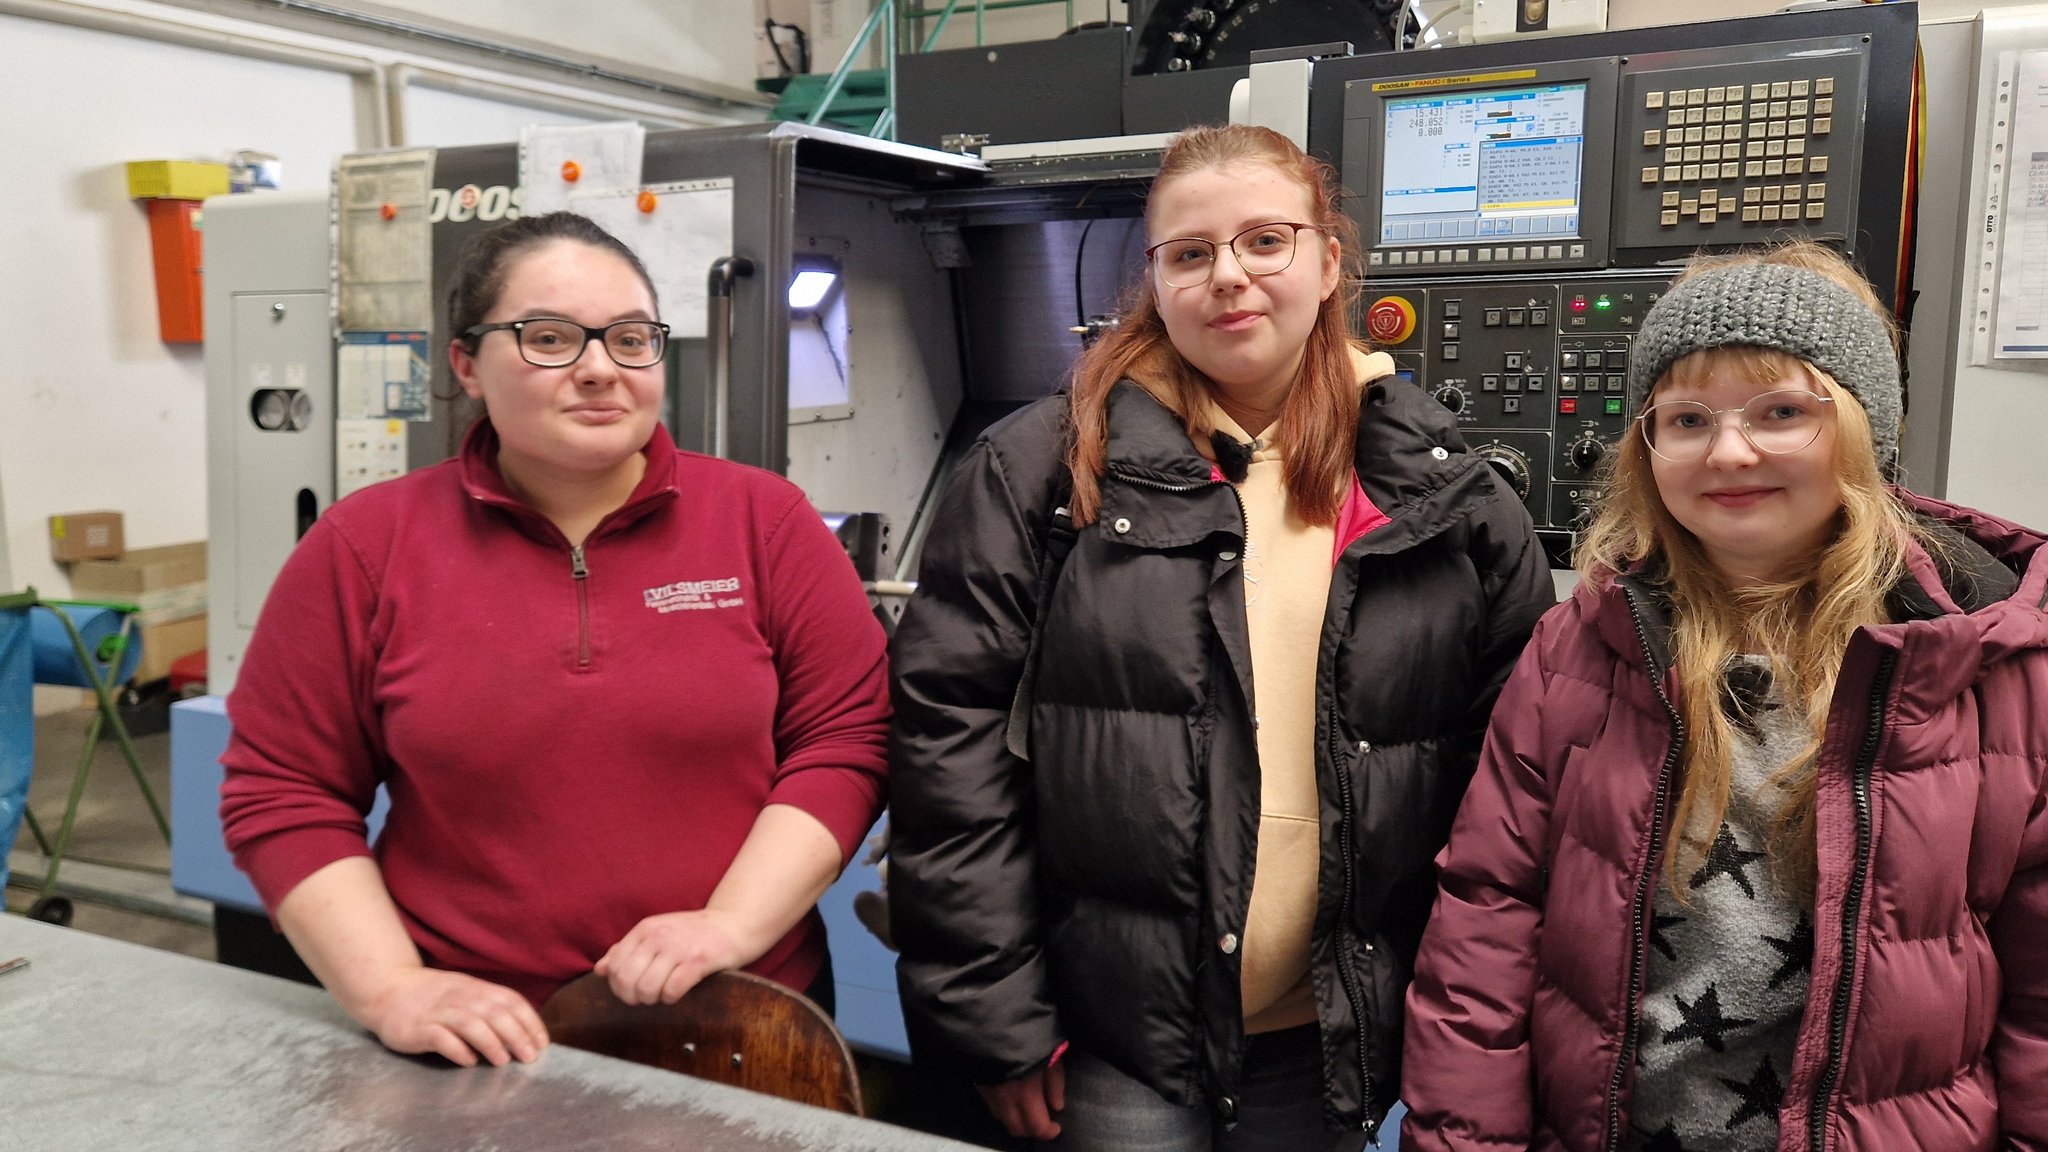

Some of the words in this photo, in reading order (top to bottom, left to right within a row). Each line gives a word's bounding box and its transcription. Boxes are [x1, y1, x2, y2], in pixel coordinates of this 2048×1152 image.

[1415, 108, 1442, 118] 15.431
[1418, 127, 1443, 137] 0.000
[649, 577, 740, 600] VILSMEIER
